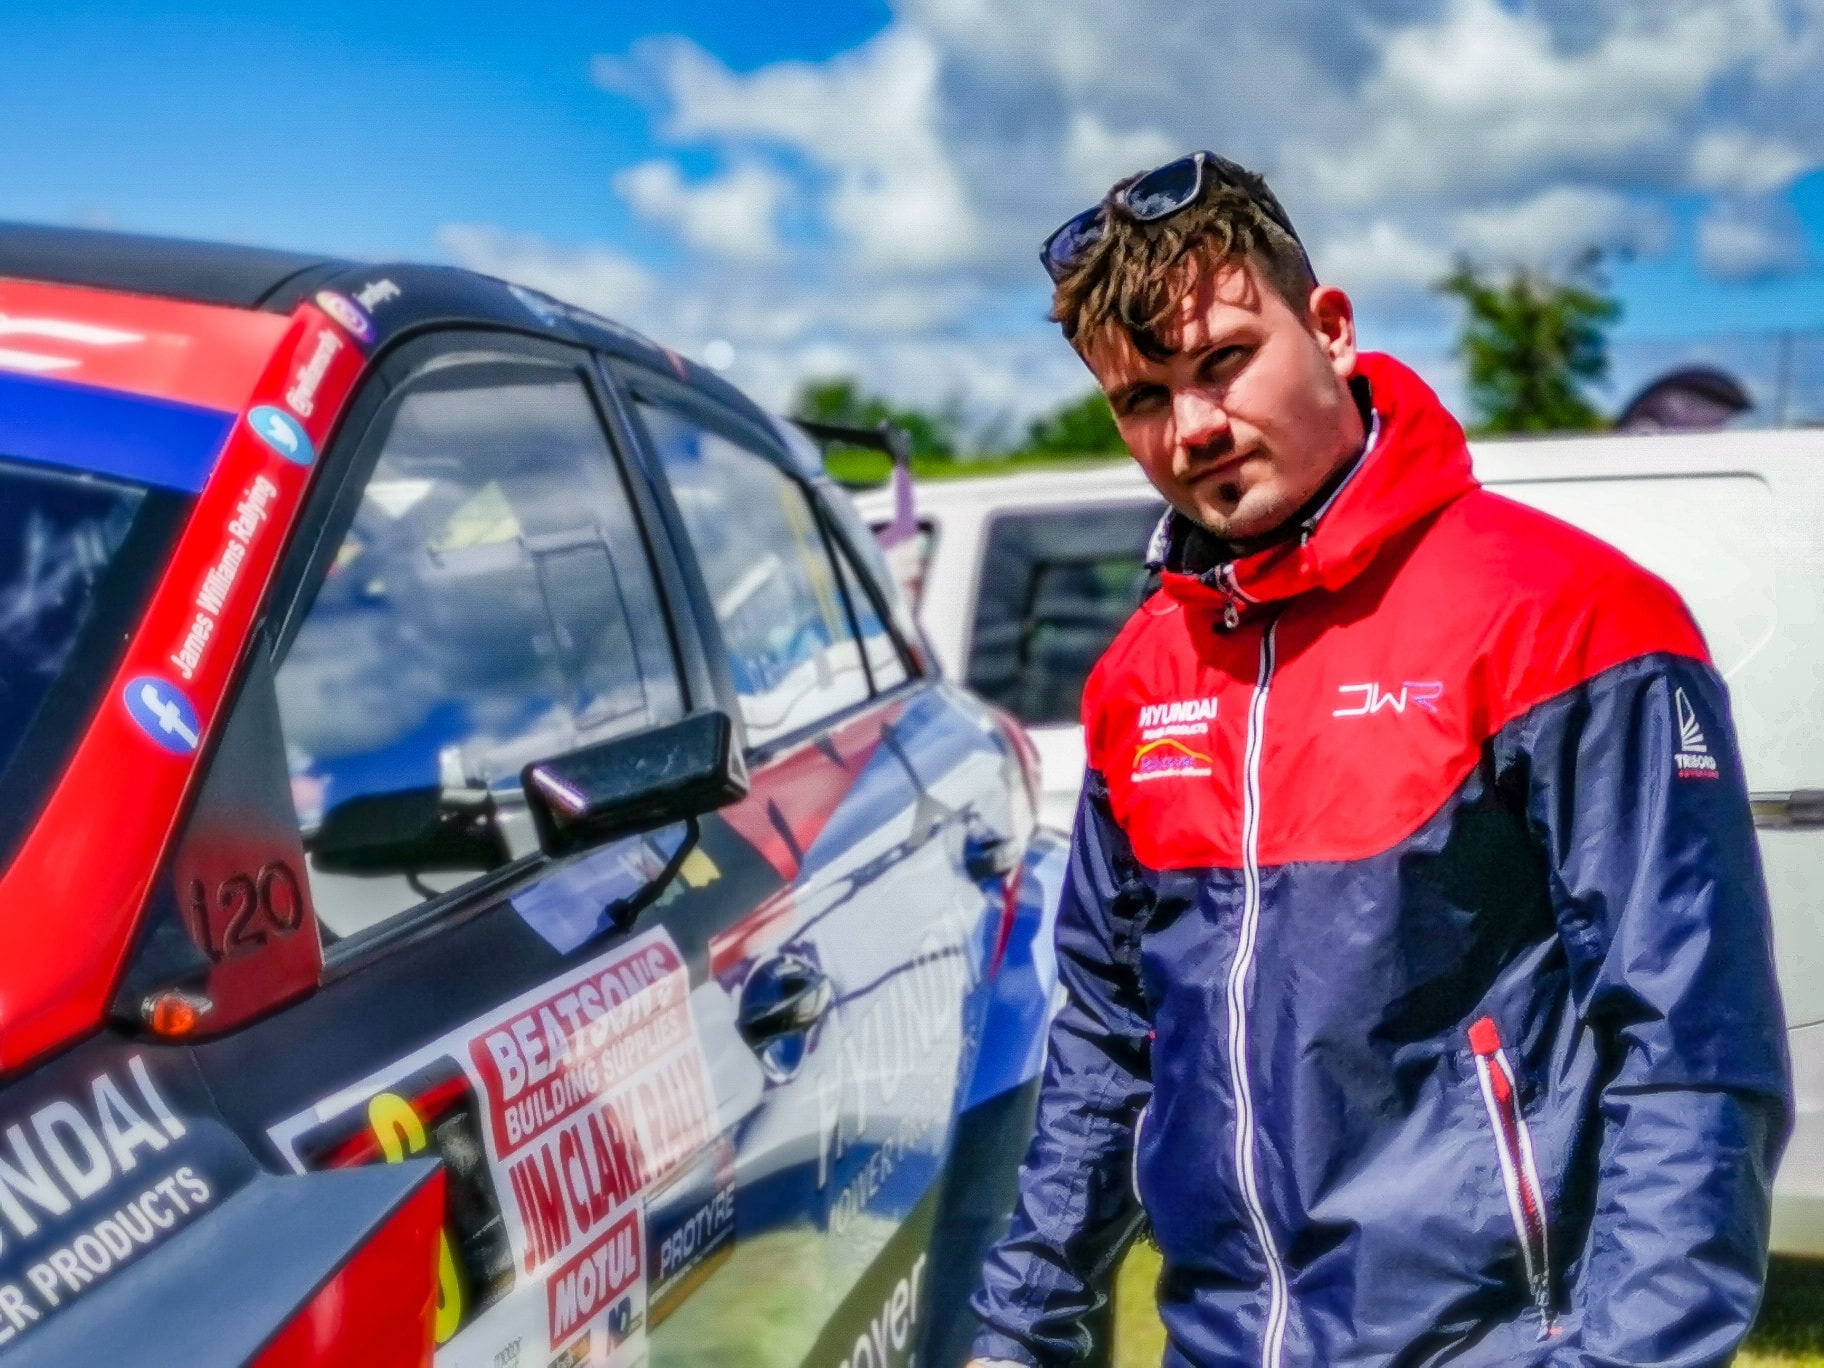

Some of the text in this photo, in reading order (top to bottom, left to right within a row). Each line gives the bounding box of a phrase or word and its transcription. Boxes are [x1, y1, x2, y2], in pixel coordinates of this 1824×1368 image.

[170, 474, 278, 680] James Williams Rallying
[1138, 697, 1218, 728] HYUNDAI
[189, 860, 302, 964] i20
[504, 1008, 682, 1147] BUILDING SUPPLIES
[0, 1054, 187, 1250] NDAI
[508, 1142, 571, 1276] JIM
[559, 1090, 651, 1234] CLARK
[26, 1167, 210, 1307] PRODUCTS
[554, 1225, 637, 1340] MOTUL
